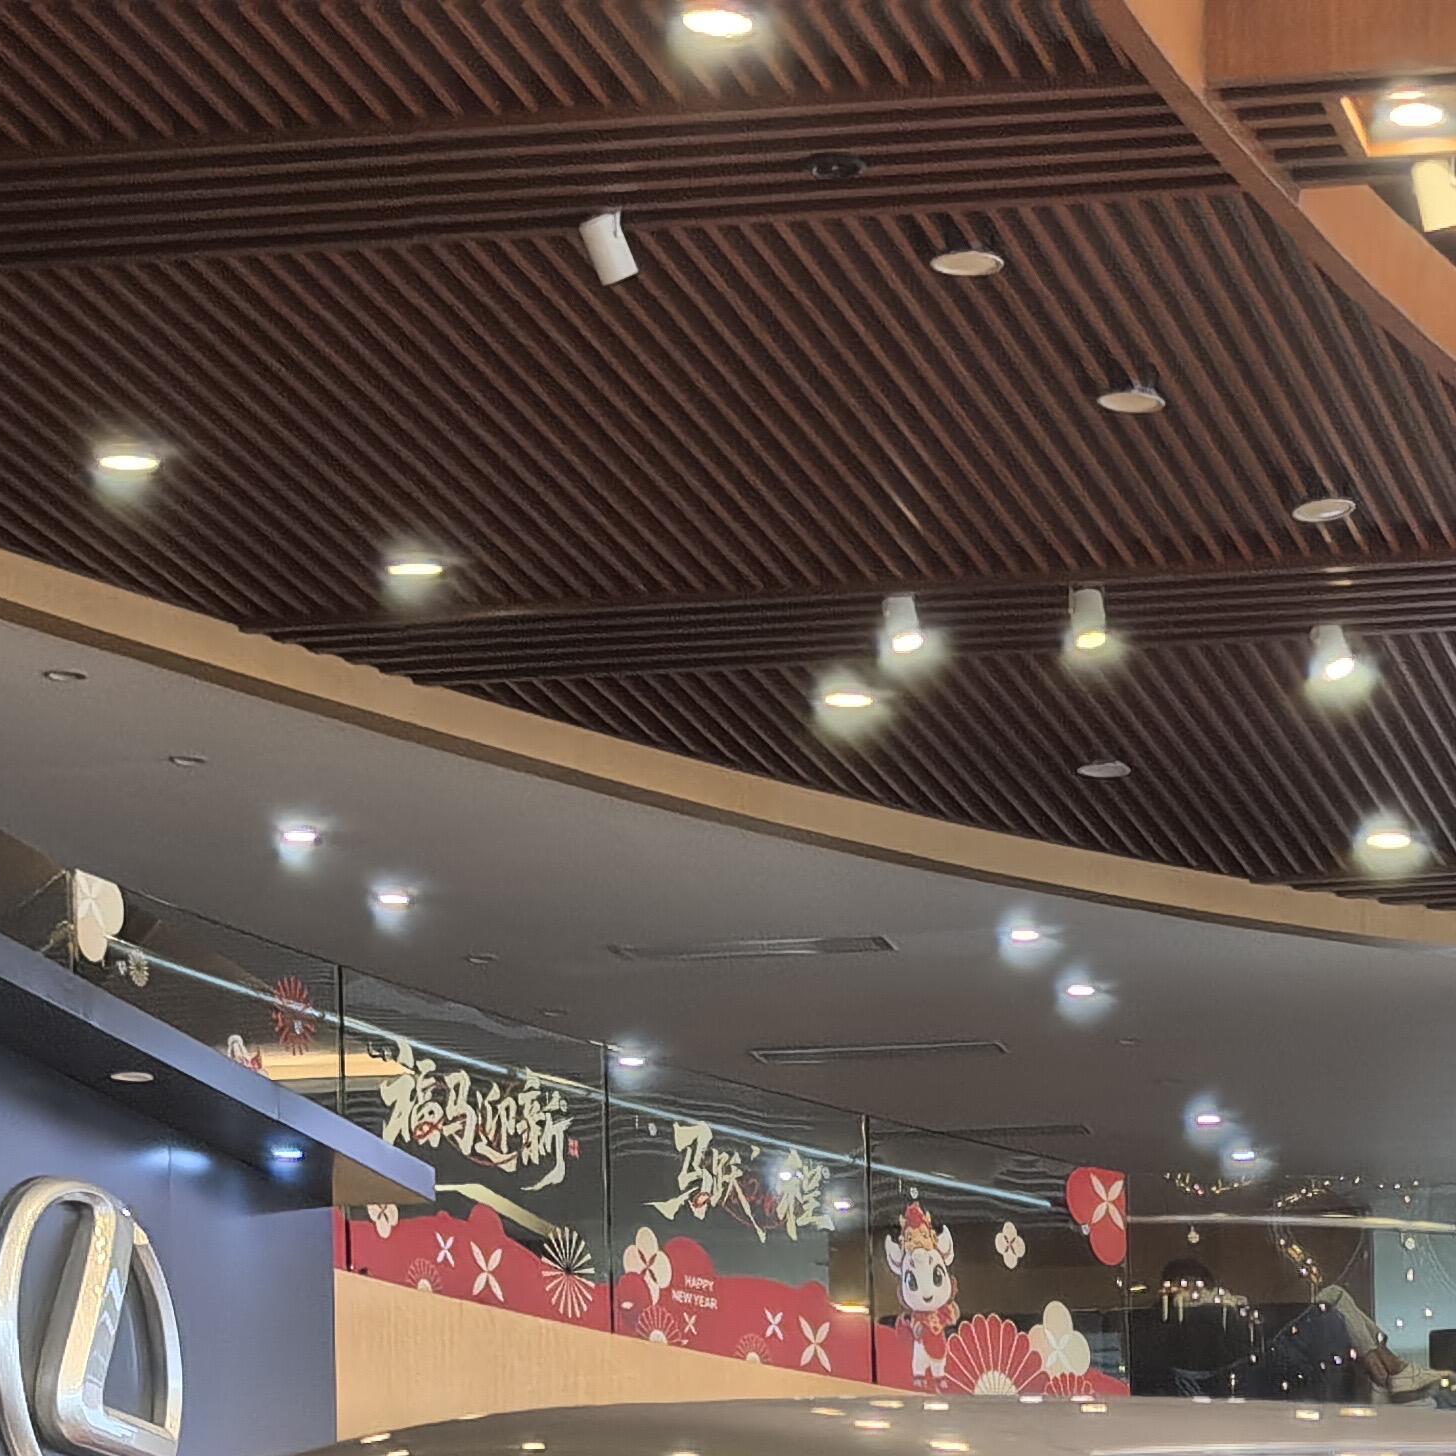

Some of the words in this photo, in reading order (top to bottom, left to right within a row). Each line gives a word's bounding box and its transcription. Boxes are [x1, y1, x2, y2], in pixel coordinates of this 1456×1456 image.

[684, 1275, 714, 1291] HAPPY
[671, 1289, 692, 1303] NEW
[693, 1294, 718, 1310] YEAR
